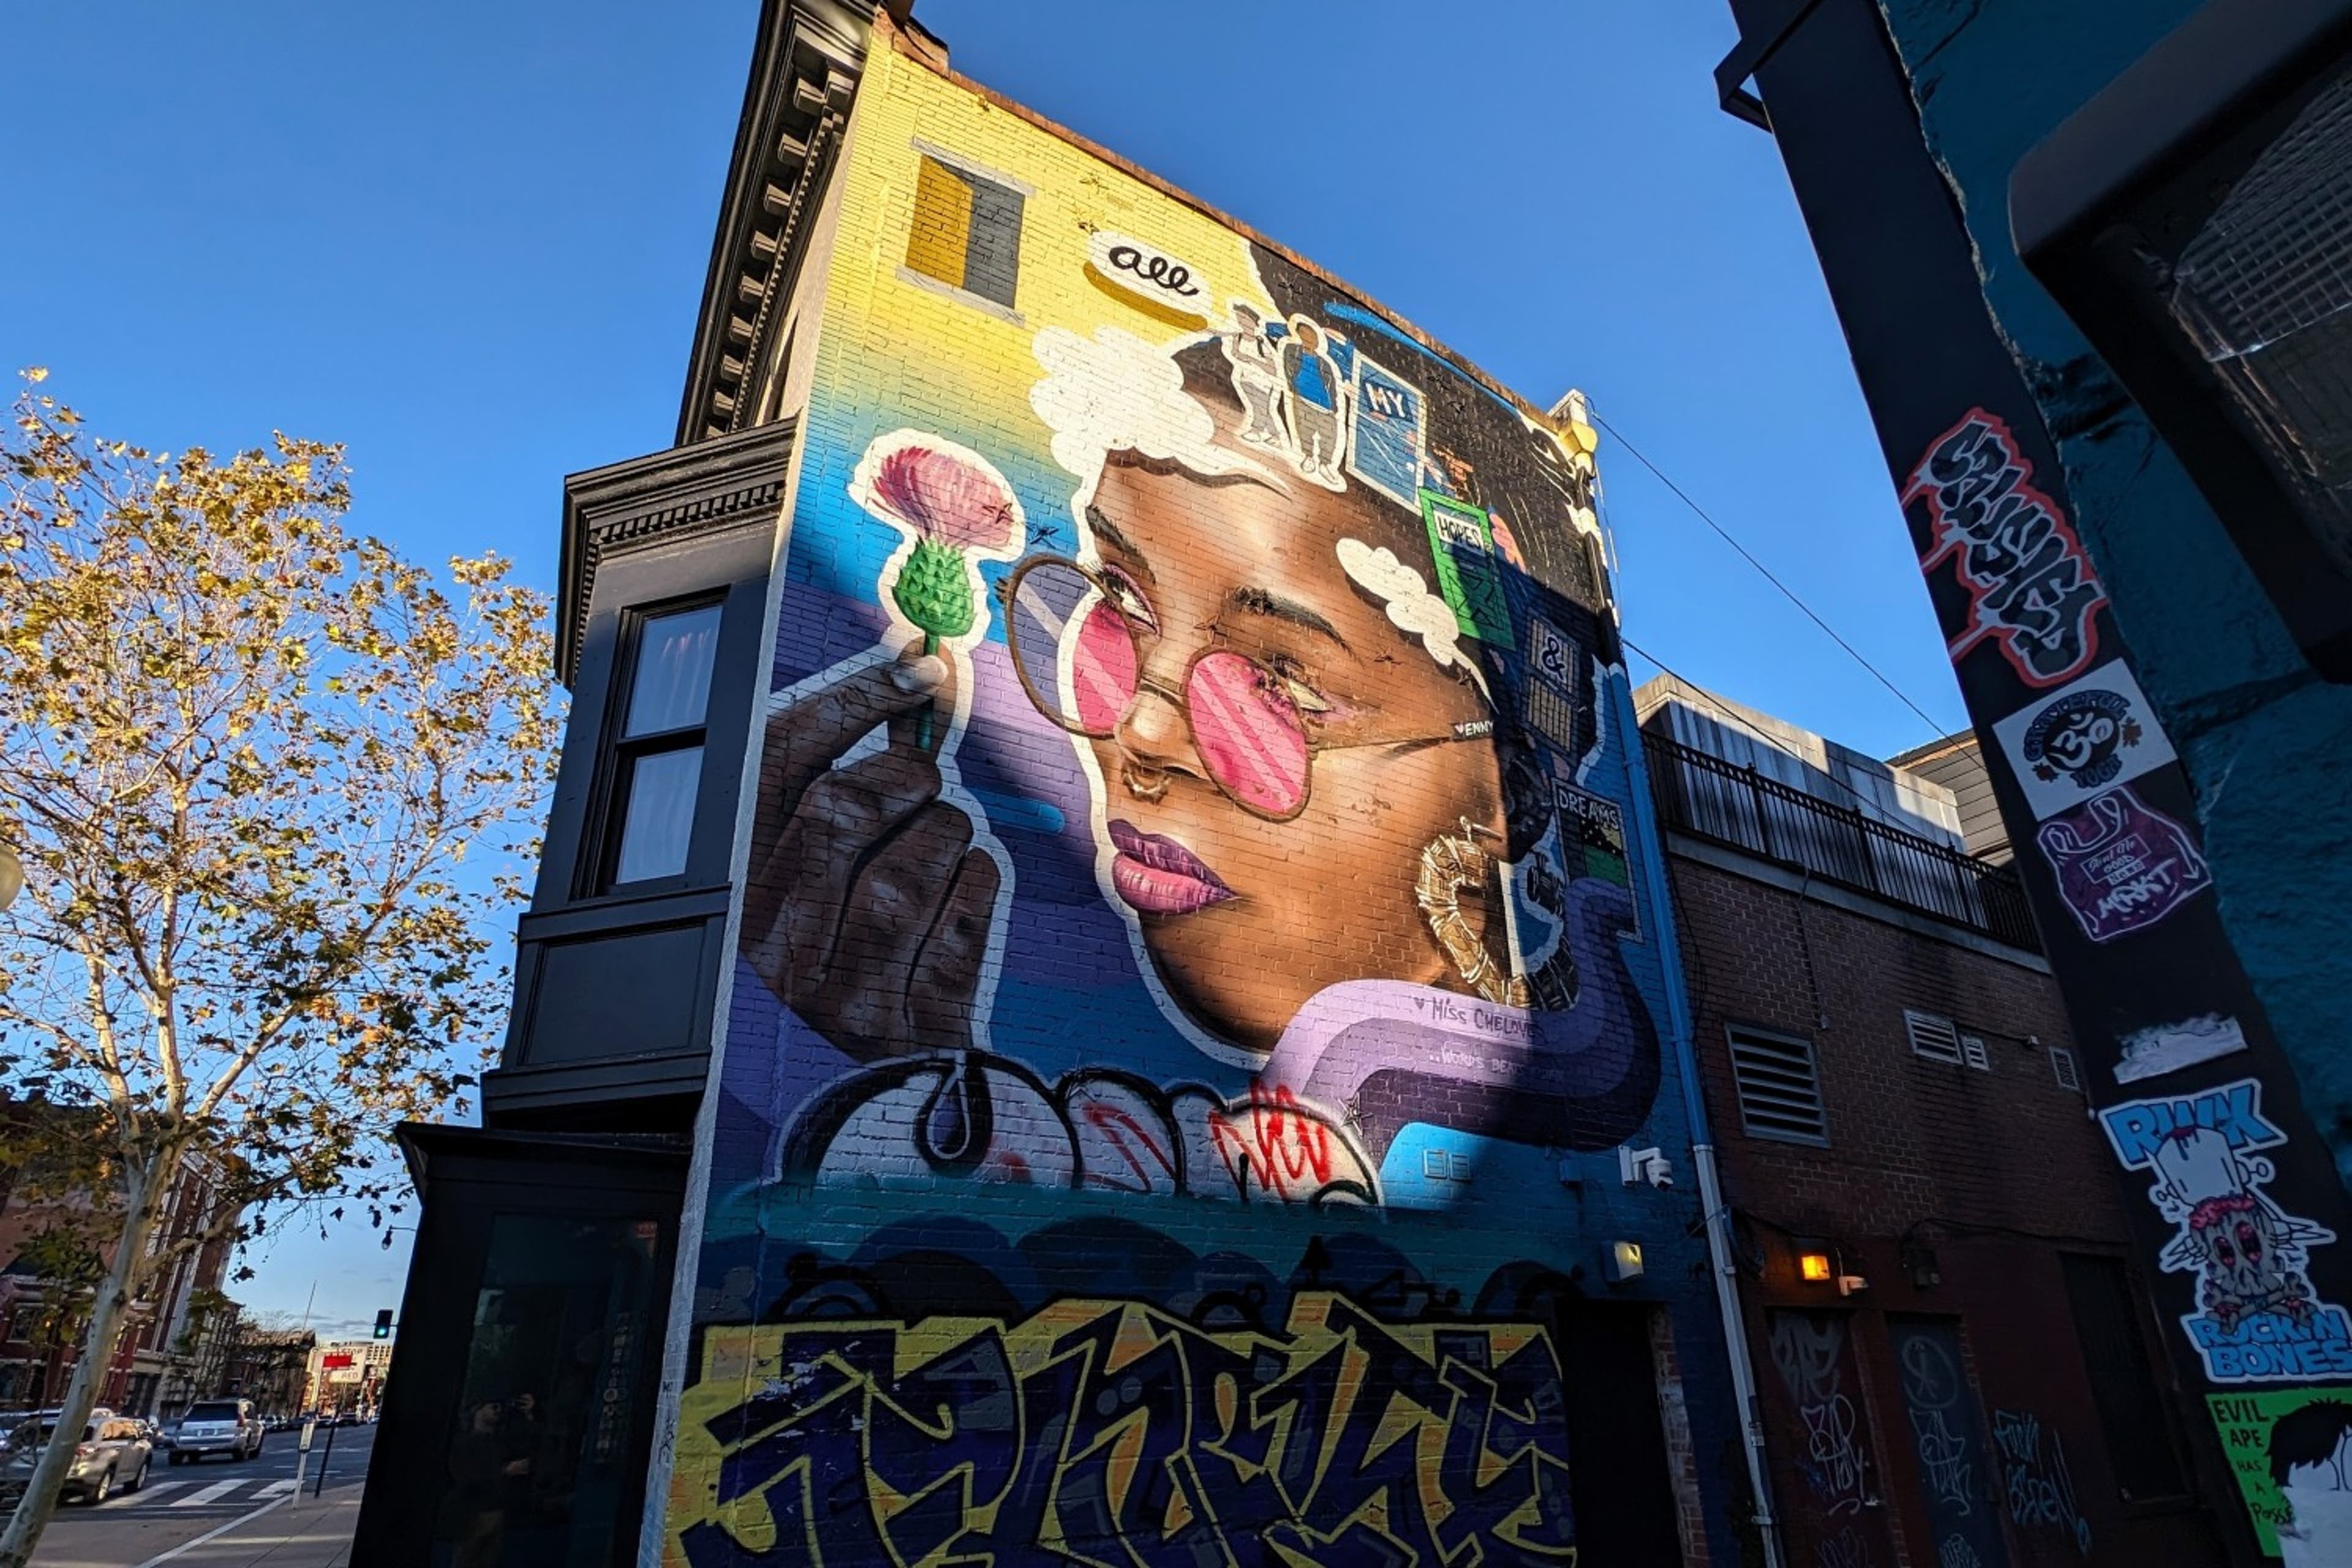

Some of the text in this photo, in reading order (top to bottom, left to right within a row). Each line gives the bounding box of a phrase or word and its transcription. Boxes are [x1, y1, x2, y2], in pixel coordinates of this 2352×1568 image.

[1368, 382, 1406, 419] MY
[1437, 516, 1482, 550] HOPES
[1542, 636, 1566, 679] &
[1558, 788, 1619, 831] DREAMS
[2211, 1339, 2352, 1376] BONES
[2212, 1400, 2270, 1423] EVIL
[2230, 1429, 2264, 1448] APE
[2237, 1460, 2263, 1473] HAS
[2255, 1479, 2266, 1495] A
